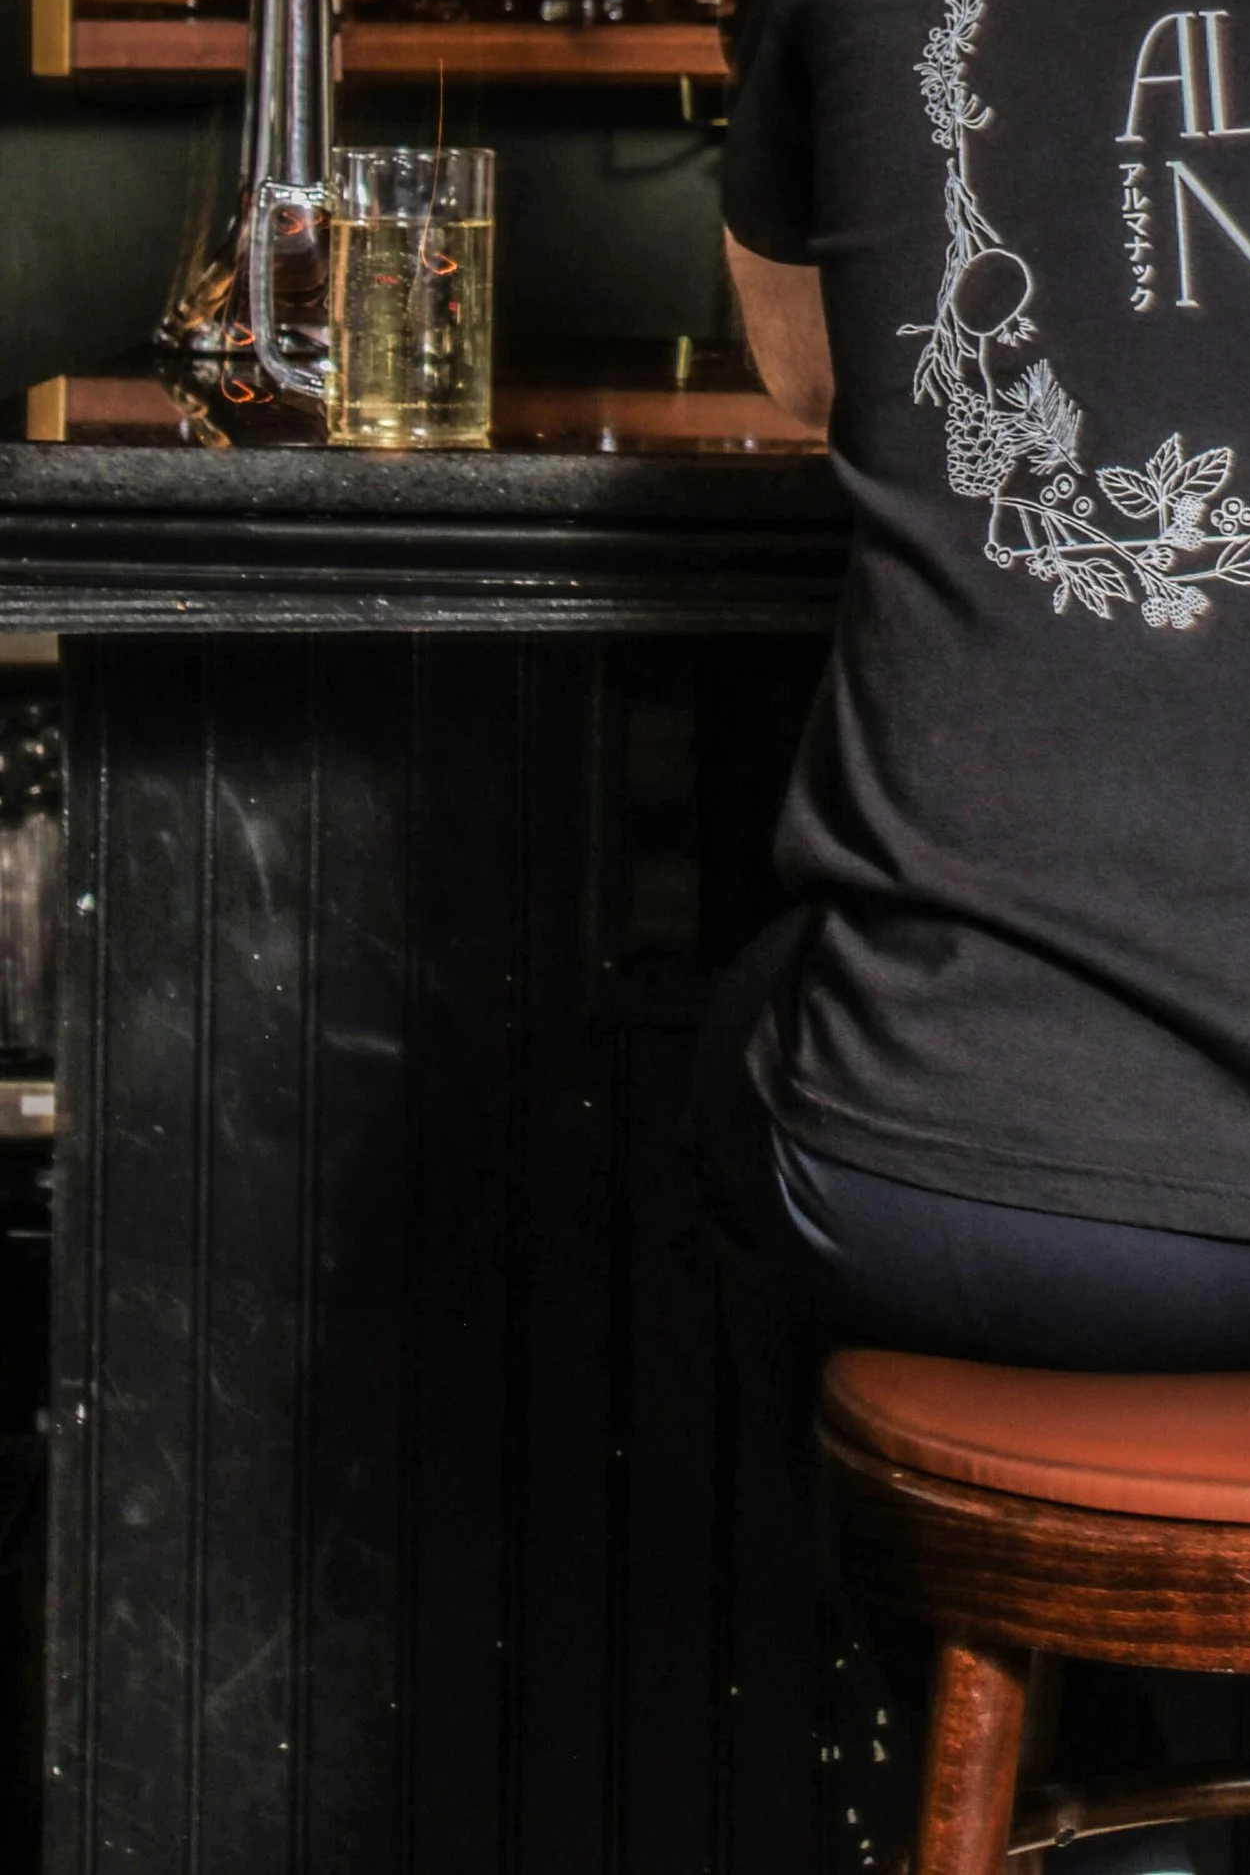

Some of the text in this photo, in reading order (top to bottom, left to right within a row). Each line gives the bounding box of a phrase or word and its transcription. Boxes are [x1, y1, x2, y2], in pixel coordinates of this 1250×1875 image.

[1118, 162, 1156, 313] アルマナック
